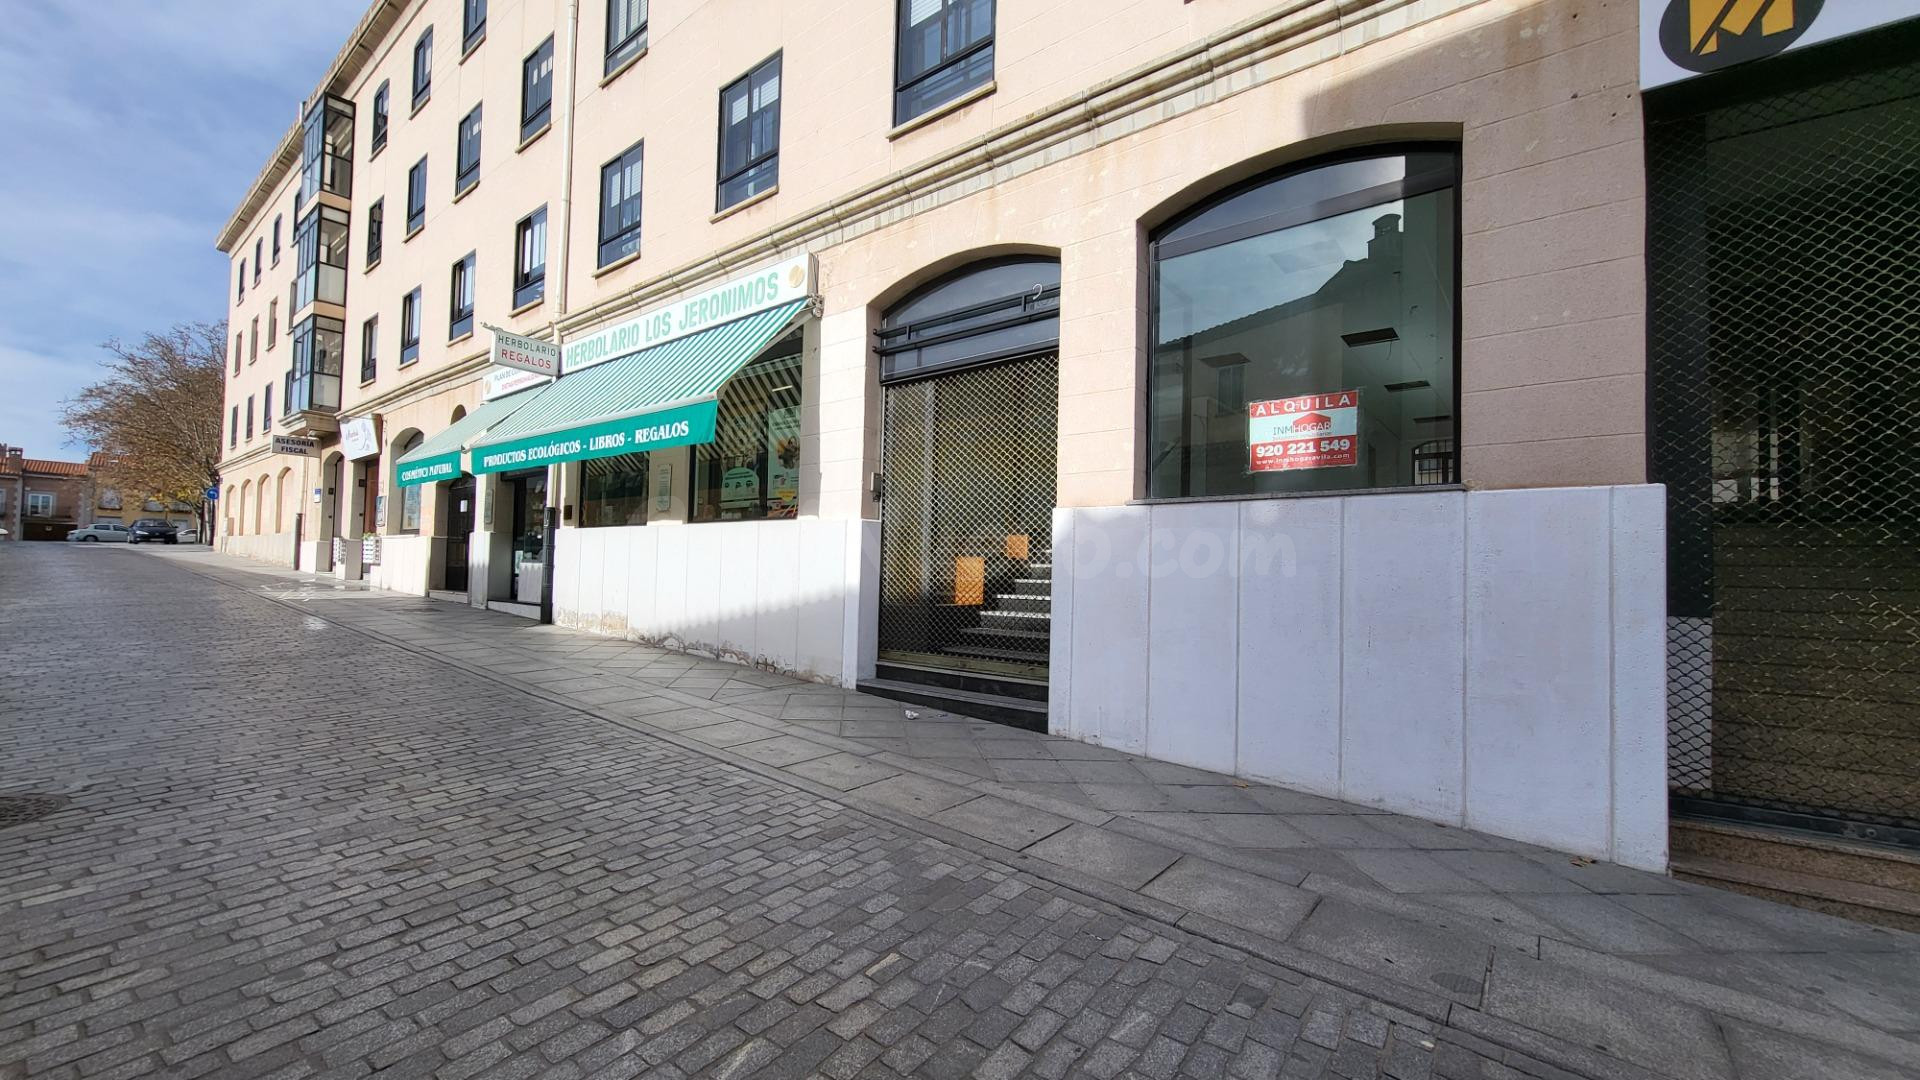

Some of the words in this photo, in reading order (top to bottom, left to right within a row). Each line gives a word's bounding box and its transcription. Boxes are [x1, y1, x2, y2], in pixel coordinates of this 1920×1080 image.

[565, 323, 640, 369] HERBOLARIO
[645, 310, 671, 342] LOS
[678, 271, 779, 331] JERONIMOS
[498, 334, 556, 357] HERBOLARIO
[501, 348, 551, 370] REGALOS
[1256, 394, 1351, 416] ALQUILA
[281, 446, 308, 455] FISCAL
[483, 450, 527, 467] PRODUCTOS
[527, 440, 581, 460] ECOLÓGICOS
[589, 432, 625, 451] LIBROS
[634, 420, 689, 444] REGALOS
[1256, 444, 1284, 457] 920
[1287, 441, 1316, 455] 221
[1320, 438, 1350, 452] 549
